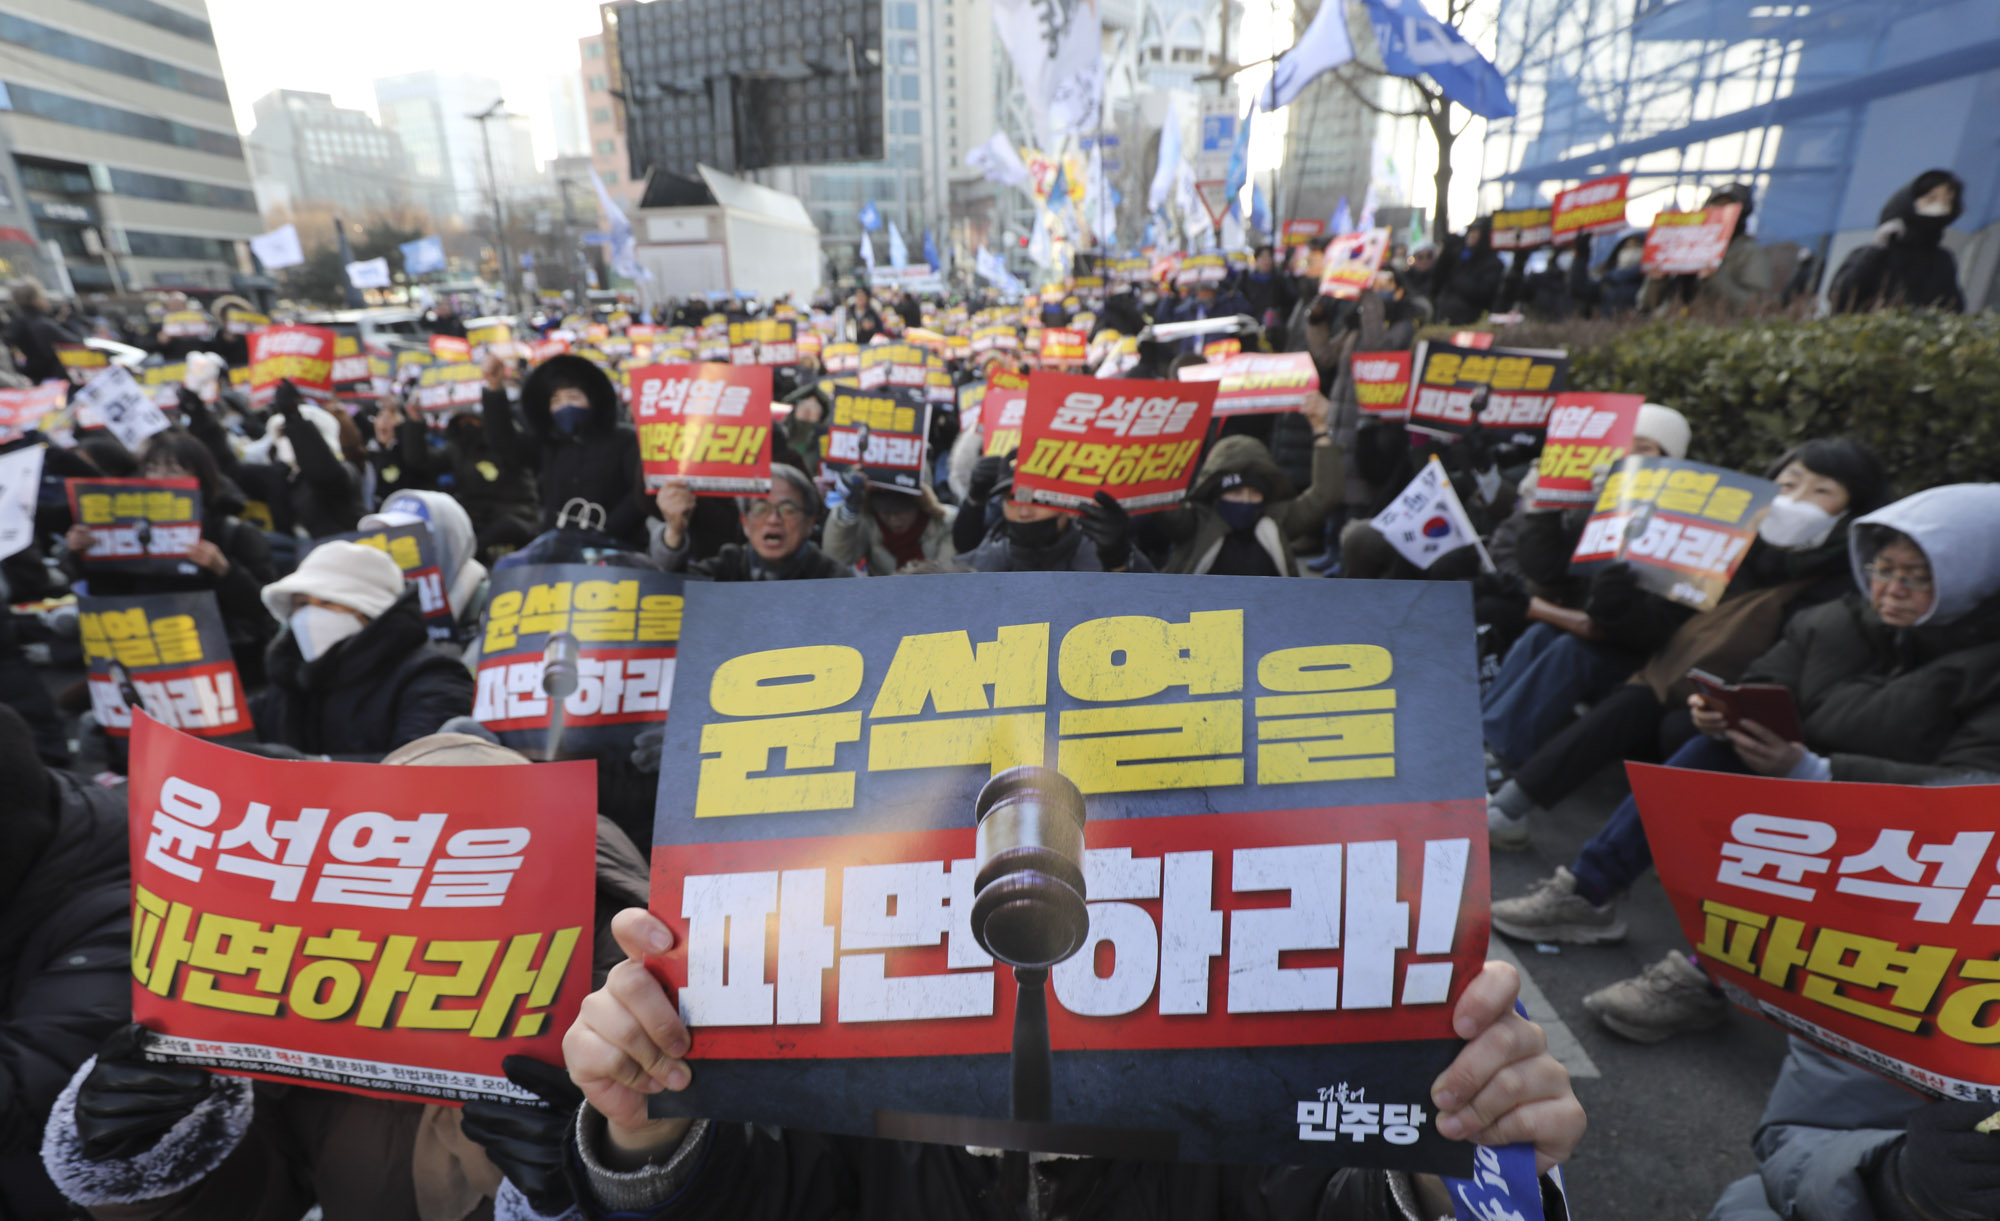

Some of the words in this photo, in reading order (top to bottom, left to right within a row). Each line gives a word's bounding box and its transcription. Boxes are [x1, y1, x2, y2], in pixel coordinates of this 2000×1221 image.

[1049, 392, 1199, 437] 윤석열을
[1020, 438, 1201, 485] 파면하라!
[482, 580, 684, 653] 윤석열을
[694, 609, 1397, 818] 윤석열을
[144, 776, 531, 909] 윤석열을
[1716, 812, 2000, 926] 윤석
[132, 883, 582, 1038] 파면하라!
[678, 838, 1471, 1027] 파면하라!
[1297, 1101, 1427, 1145] 민주당
[1317, 1081, 1366, 1103] 더불어
